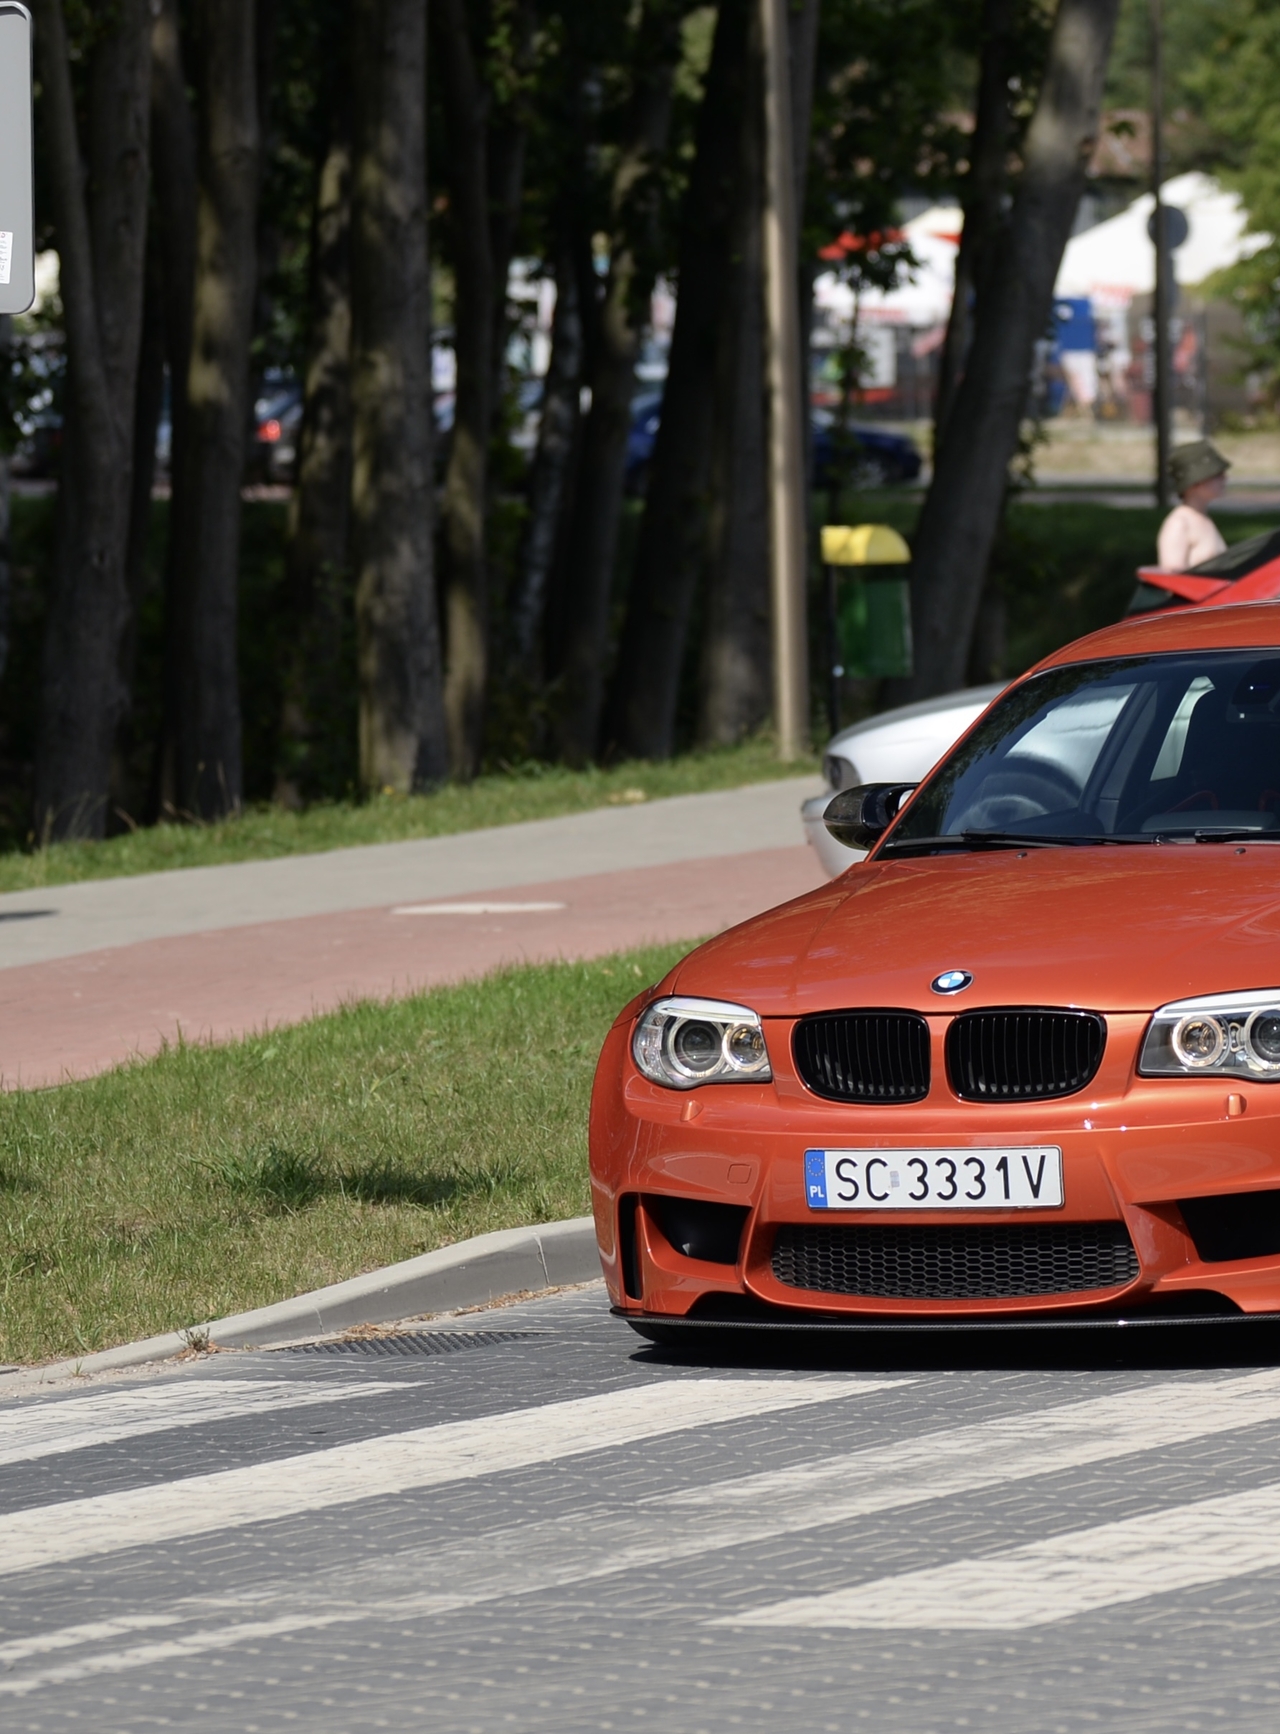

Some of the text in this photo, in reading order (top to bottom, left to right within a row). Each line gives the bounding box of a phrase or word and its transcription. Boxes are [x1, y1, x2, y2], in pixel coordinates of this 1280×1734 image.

[809, 1185, 825, 1198] PL
[835, 1154, 1047, 1202] SC 3331V
